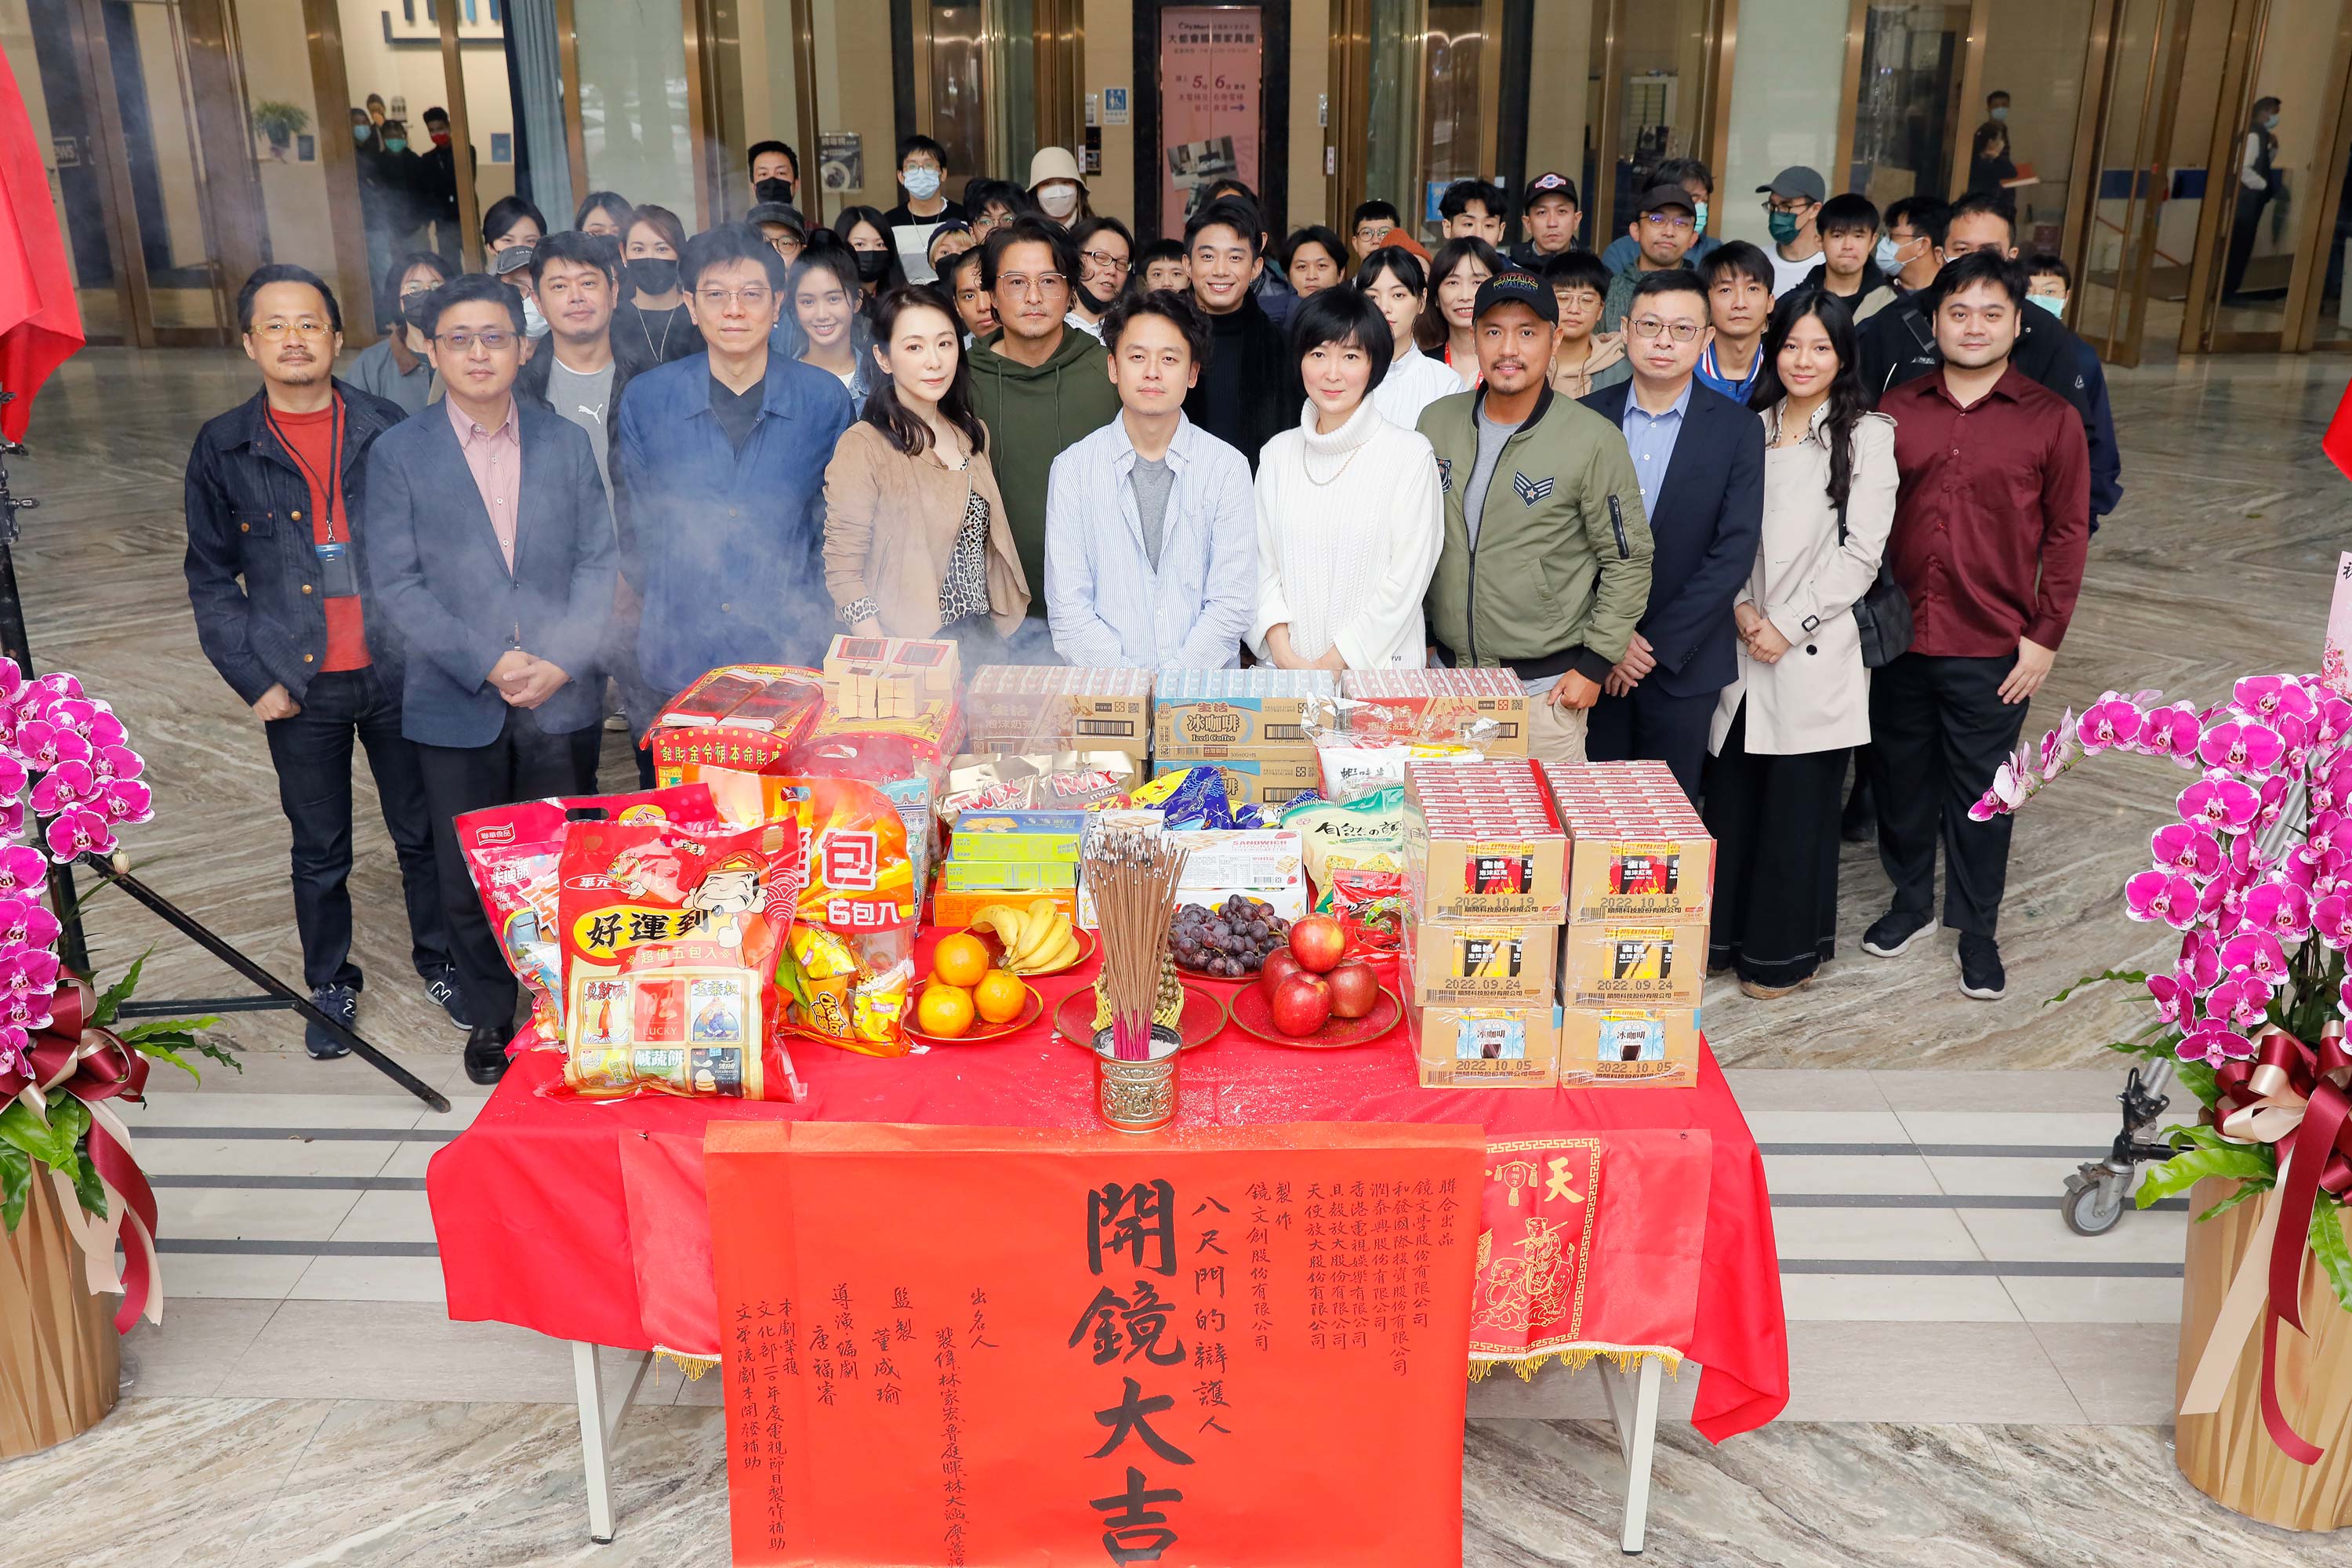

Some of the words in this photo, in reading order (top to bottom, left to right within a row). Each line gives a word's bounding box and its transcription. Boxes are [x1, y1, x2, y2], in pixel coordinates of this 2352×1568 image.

[1494, 272, 1538, 289] STAR
[1197, 702, 1229, 713] 生活
[1186, 713, 1240, 732] 冰咖啡
[1210, 734, 1236, 742] Coffee
[1090, 786, 1123, 801] minis
[1482, 860, 1506, 869] 生活
[1627, 860, 1651, 869] 生活
[578, 877, 614, 888] 華元
[828, 900, 901, 926] 6包入
[586, 909, 711, 950] 好運到
[640, 946, 719, 964] 超值五包入
[1445, 979, 1521, 989] 2022.09.24
[1598, 980, 1673, 990] 2022.09.24
[643, 1026, 677, 1036] LUCKY
[635, 1050, 684, 1067] 鹹蔬餅
[1456, 1060, 1532, 1070] 2022.10.05
[1597, 1062, 1672, 1073] 2022.10.05
[1544, 1156, 1585, 1204] 天
[1276, 1181, 1293, 1231] 製作
[1412, 1178, 1434, 1329] 鏡文學股份有限公司
[1245, 1181, 1274, 1352] 鏡文創股份有限公司
[1305, 1182, 1329, 1351] 天使放大股份有限公司
[891, 1287, 917, 1342] 監製
[809, 1324, 838, 1406] 唐福睿
[872, 1327, 902, 1406] 董成瑜
[1068, 1178, 1196, 1567] 開鏡大吉
